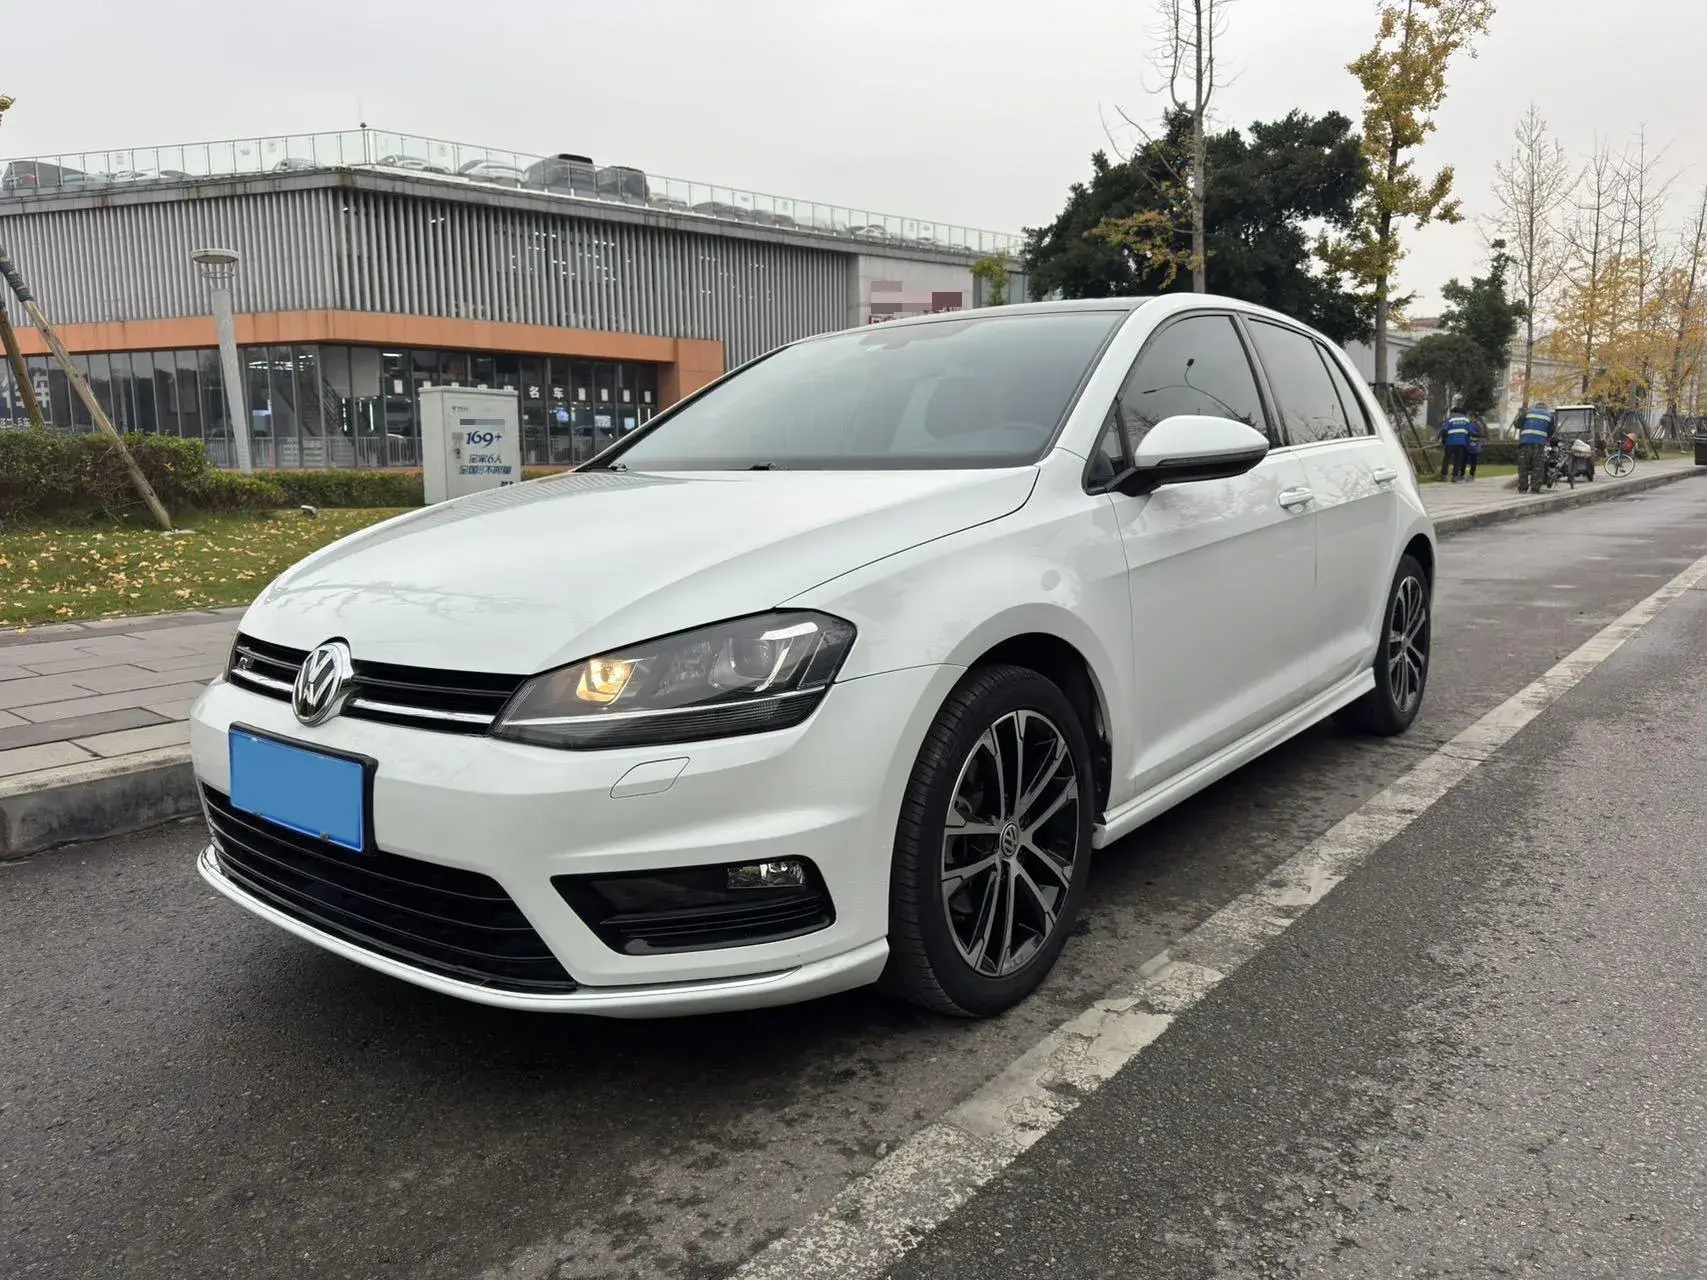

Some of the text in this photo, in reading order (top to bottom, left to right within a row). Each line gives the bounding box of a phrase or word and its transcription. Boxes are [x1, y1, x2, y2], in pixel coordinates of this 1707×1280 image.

[466, 430, 503, 449] 169+
[469, 454, 502, 464] 全家6人
